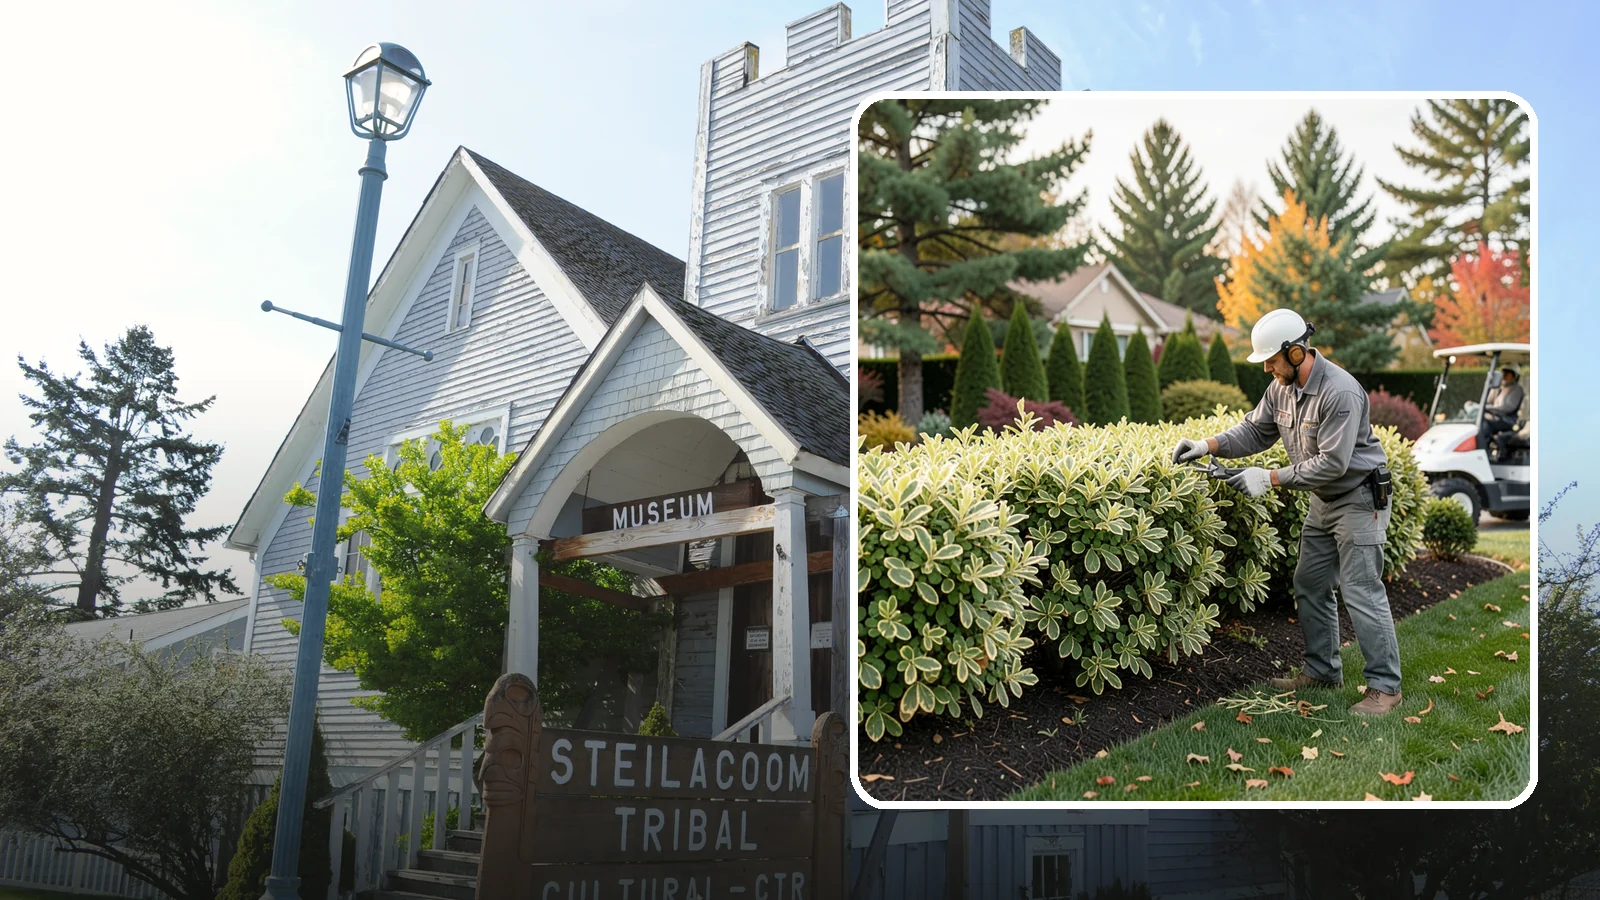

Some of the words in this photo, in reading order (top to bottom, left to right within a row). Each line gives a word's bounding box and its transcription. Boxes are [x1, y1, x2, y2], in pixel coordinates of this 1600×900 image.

[613, 491, 713, 531] MUSEUM
[550, 738, 809, 793] STEILACOOM
[614, 806, 758, 852] TRIBAL
